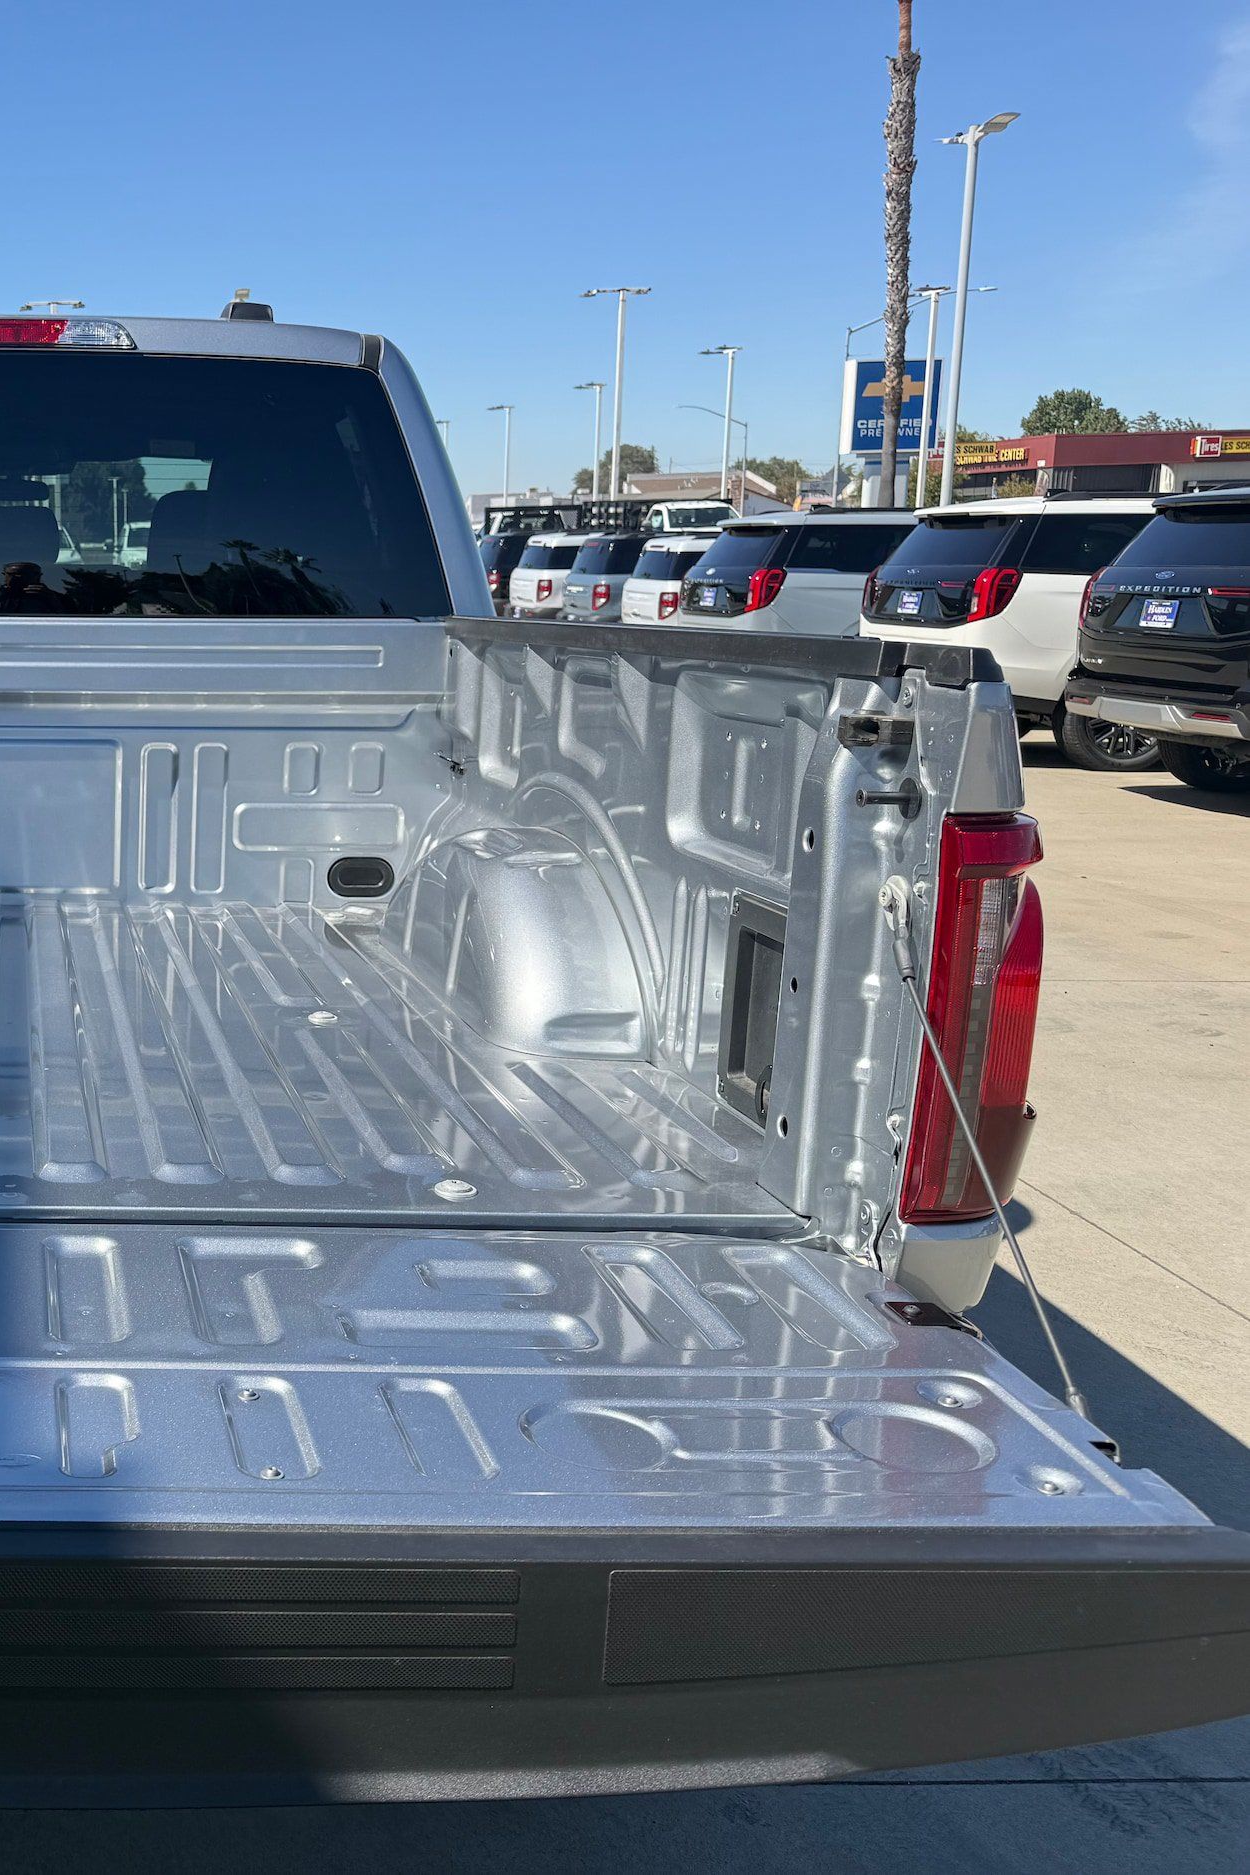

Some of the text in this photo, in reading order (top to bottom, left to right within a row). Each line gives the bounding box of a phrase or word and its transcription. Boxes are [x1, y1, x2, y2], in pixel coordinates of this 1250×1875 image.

[963, 445, 995, 455] SCHWAB
[1000, 448, 1025, 462] CENTER
[1119, 584, 1202, 594] EXPEDITION
